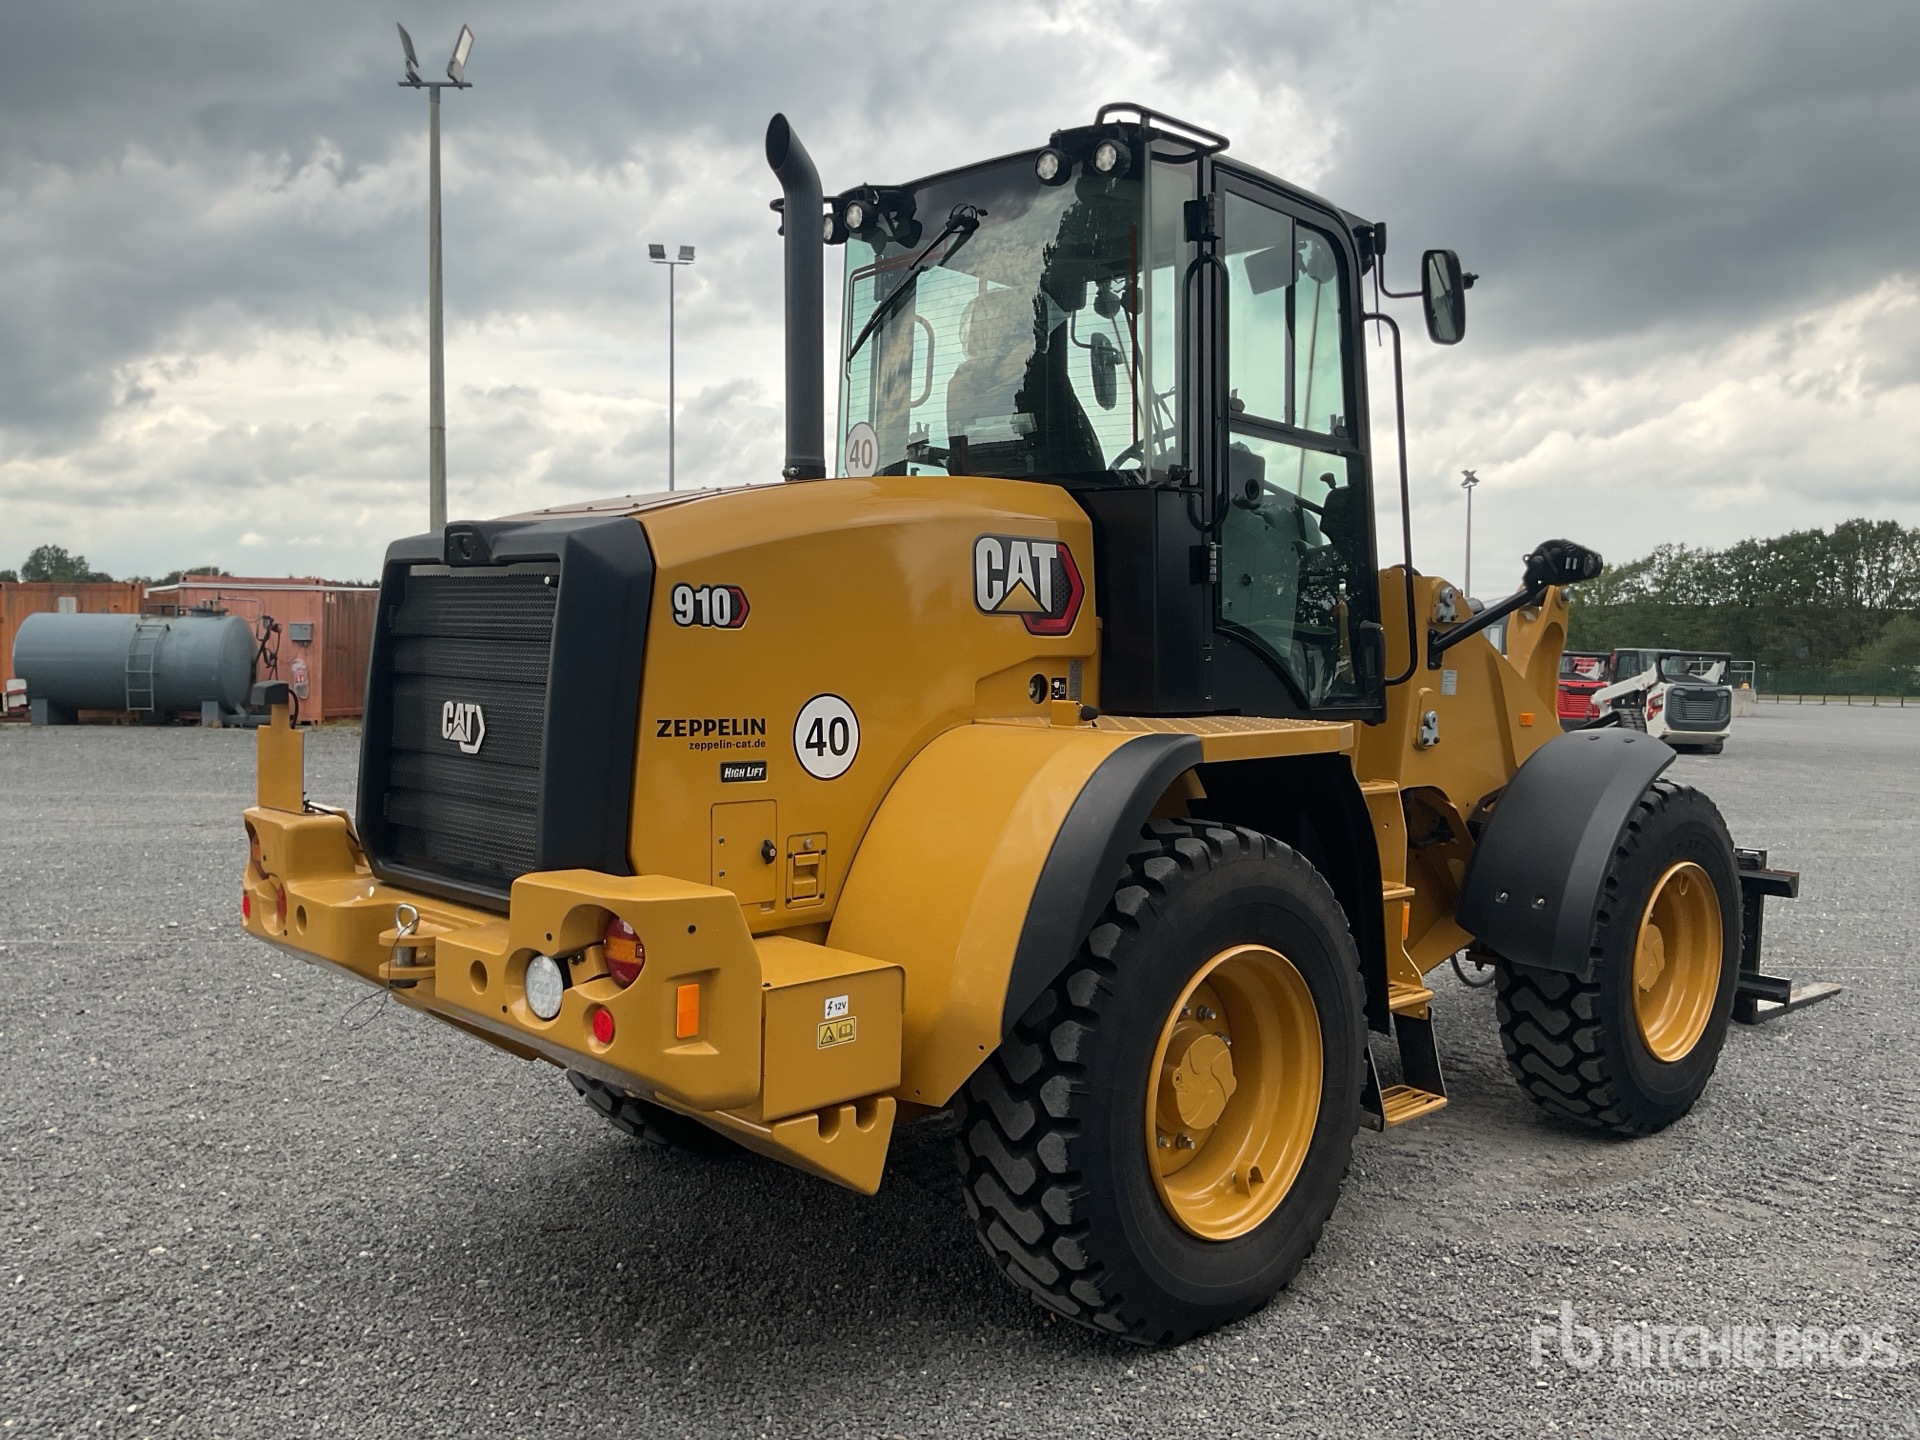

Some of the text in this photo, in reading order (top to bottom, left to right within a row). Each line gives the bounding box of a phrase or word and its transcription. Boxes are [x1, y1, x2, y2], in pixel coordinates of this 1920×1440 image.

[850, 439, 872, 469] 40
[976, 538, 1057, 613] CAT
[674, 586, 731, 626] 910
[442, 701, 476, 742] CAT
[656, 718, 766, 738] ZEPPELIN
[805, 716, 849, 757] 40
[689, 739, 766, 751] zeppelin-cat.de
[834, 1001, 846, 1010] 12V
